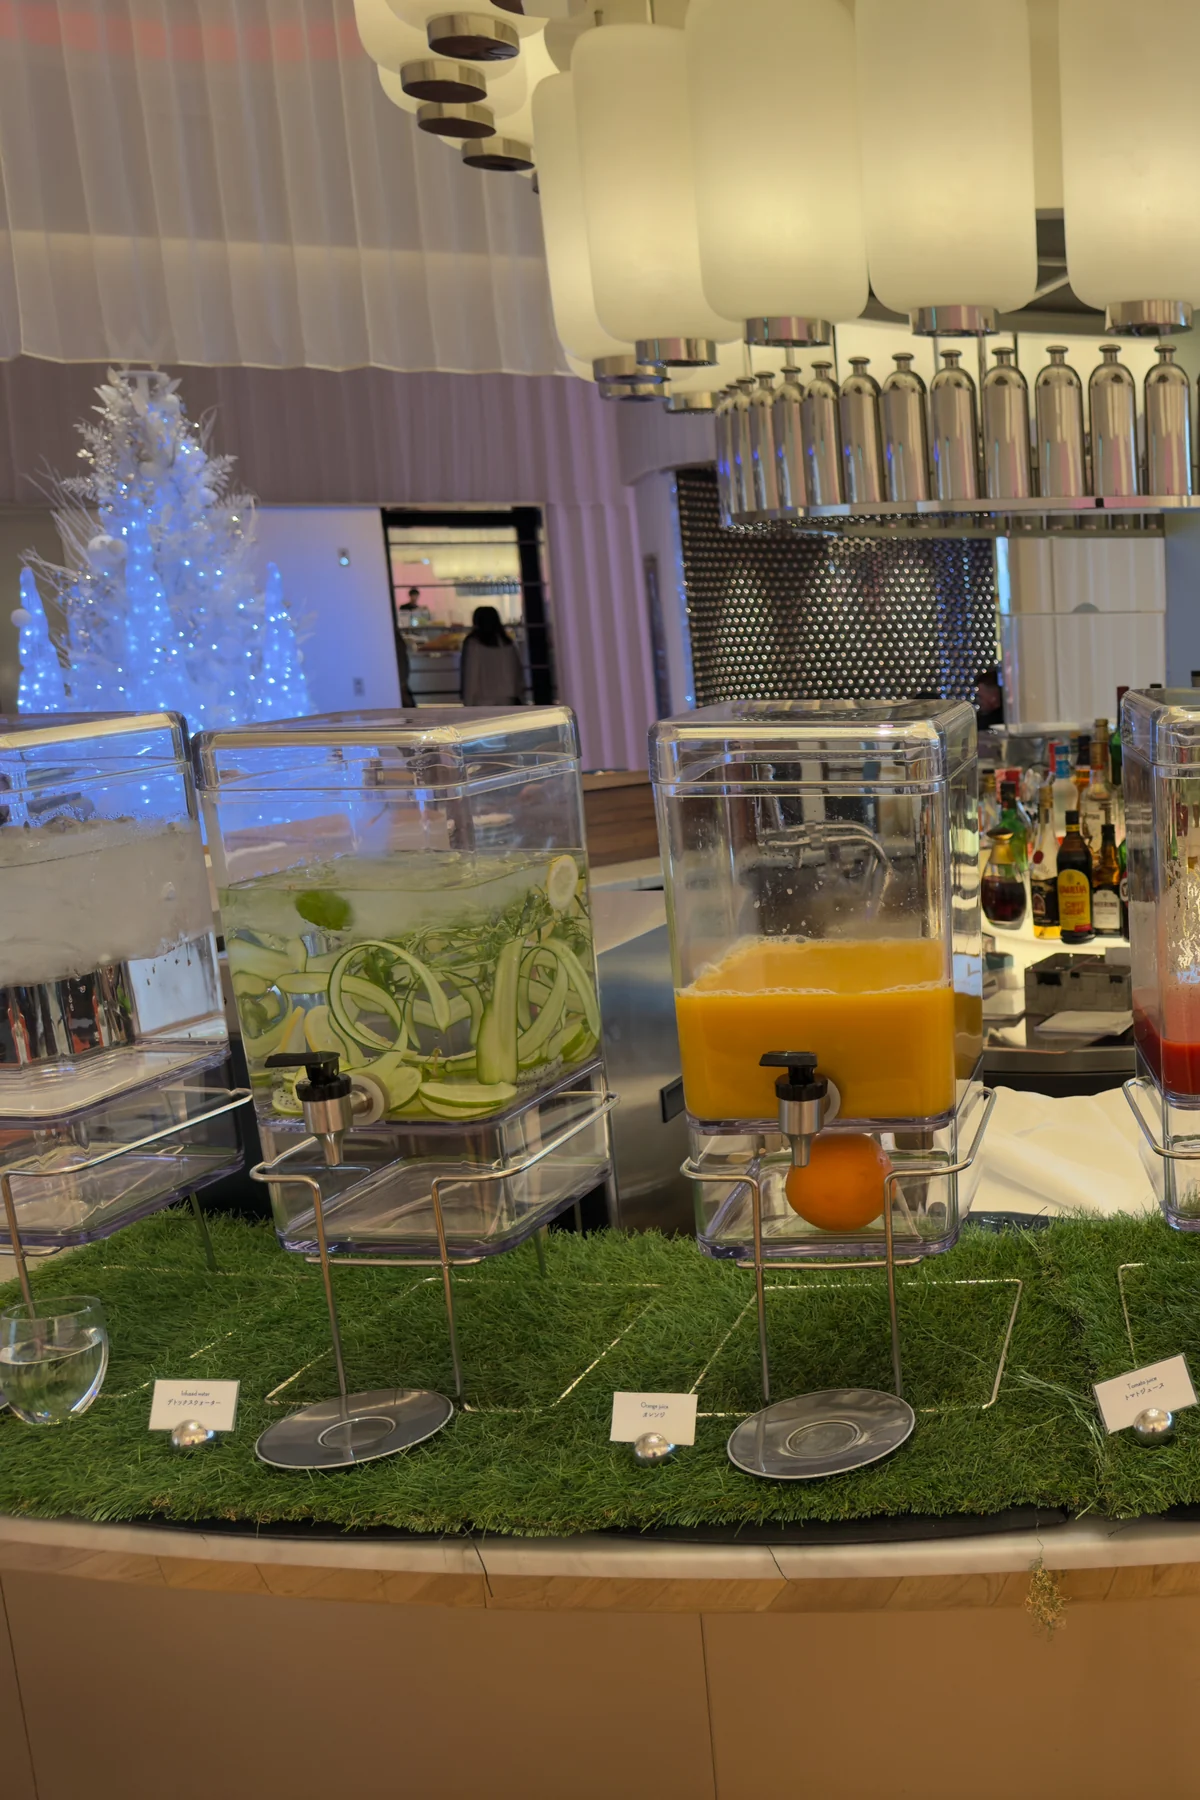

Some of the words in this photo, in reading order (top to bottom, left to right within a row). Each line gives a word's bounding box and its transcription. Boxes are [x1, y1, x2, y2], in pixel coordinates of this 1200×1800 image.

[1126, 1379, 1146, 1390] Tomato
[1125, 1382, 1165, 1401] トマトジュース
[640, 1401, 658, 1409] Orange
